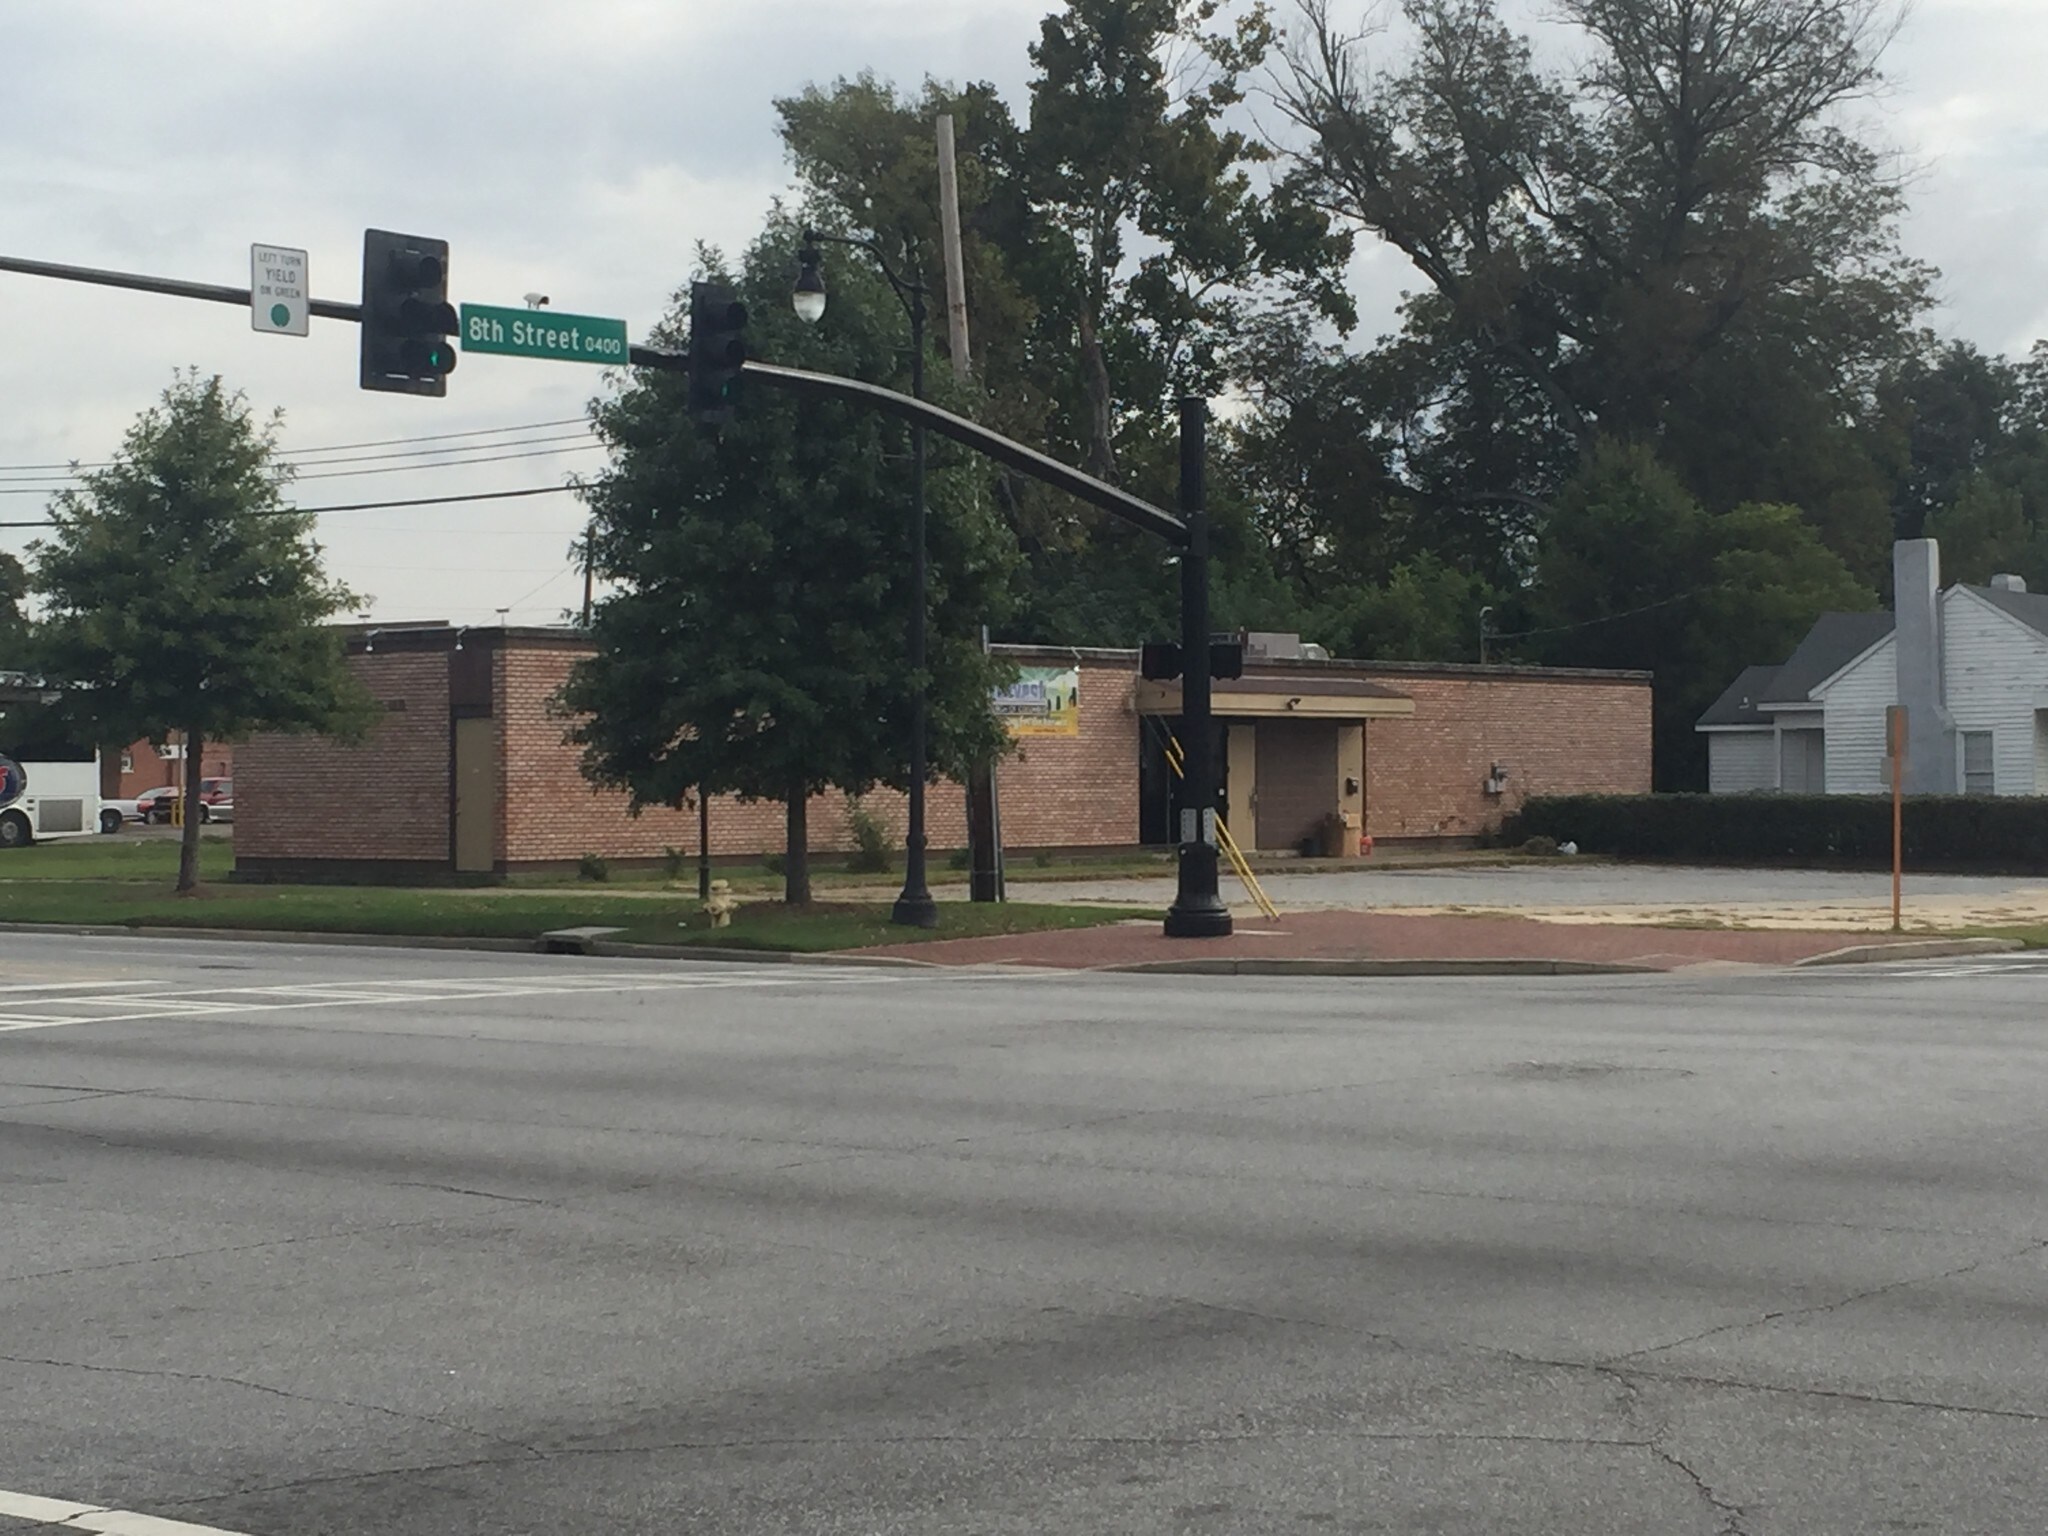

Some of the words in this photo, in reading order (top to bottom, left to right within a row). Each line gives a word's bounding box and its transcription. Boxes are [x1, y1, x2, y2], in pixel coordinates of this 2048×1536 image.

[258, 252, 277, 263] LEFT
[280, 254, 302, 266] TURN
[265, 267, 296, 284] YIELD
[260, 284, 272, 295] ON
[274, 286, 301, 298] GREEN
[469, 316, 504, 343] 8th
[512, 320, 580, 351] Street
[584, 336, 621, 355] 0400
